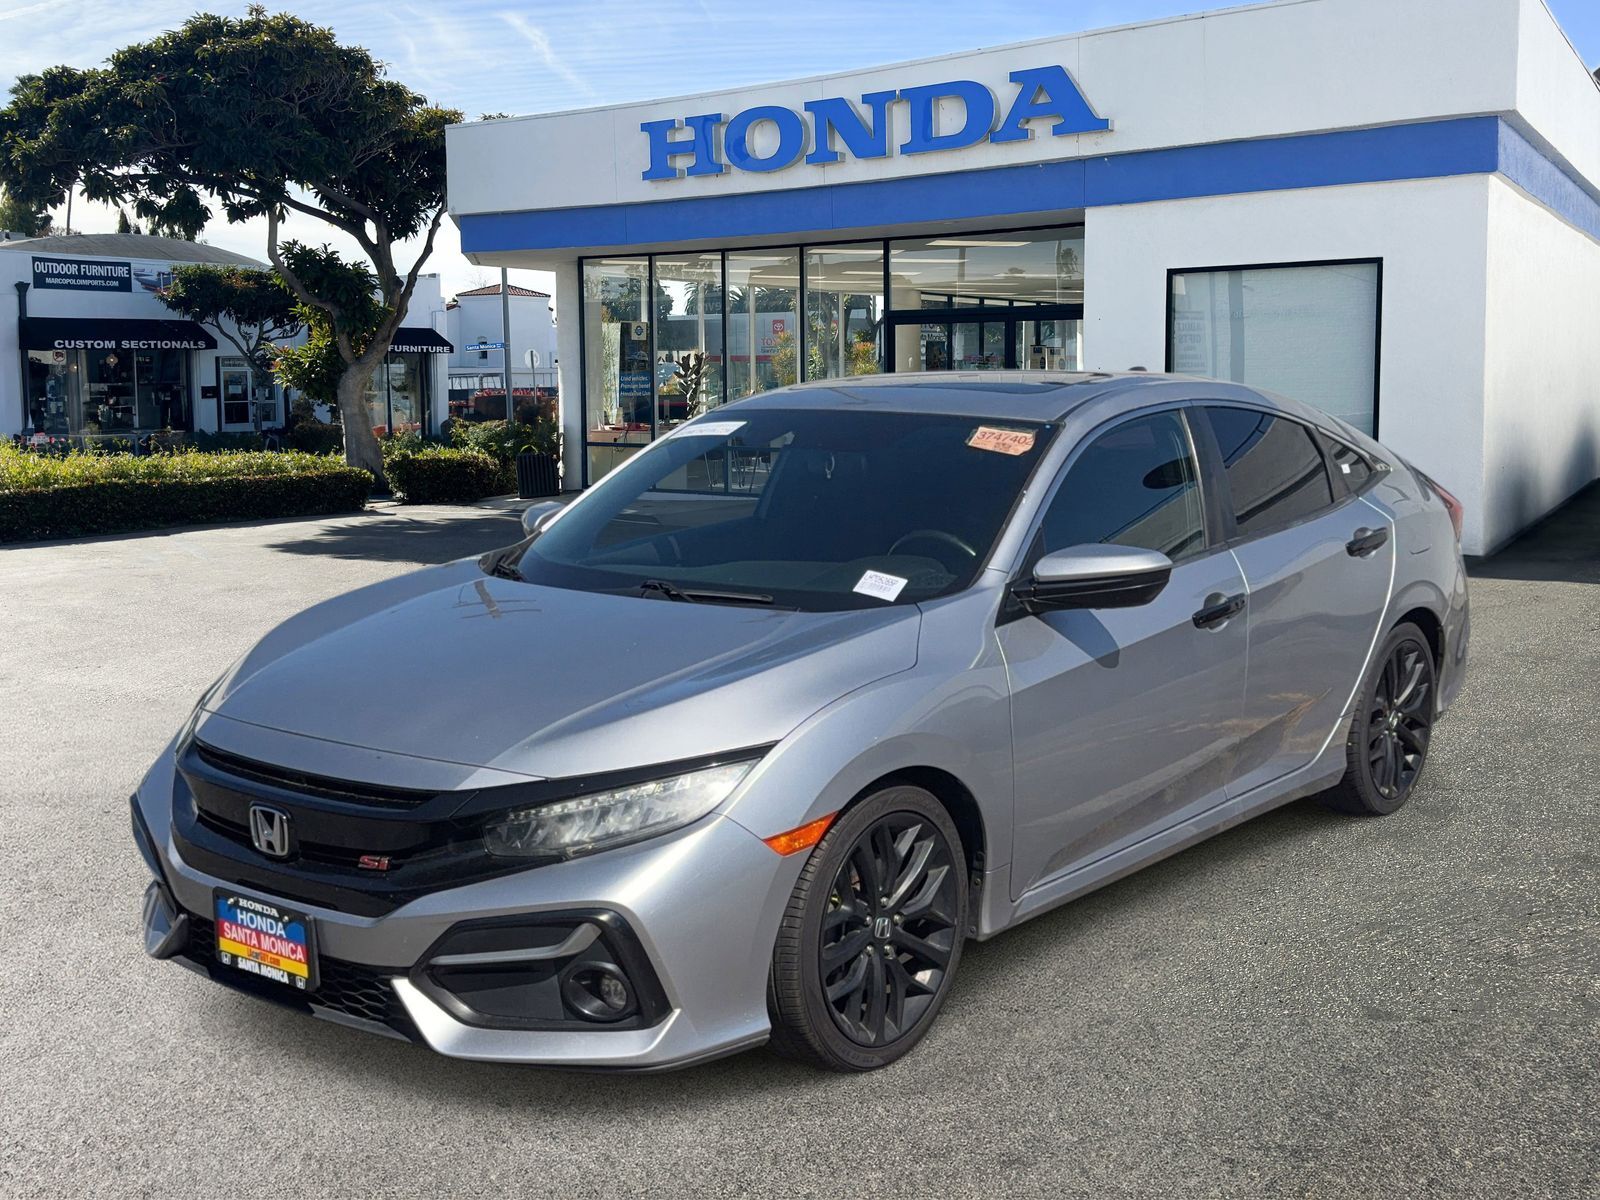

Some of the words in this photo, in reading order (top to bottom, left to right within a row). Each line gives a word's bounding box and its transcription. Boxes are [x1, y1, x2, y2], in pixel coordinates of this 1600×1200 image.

[640, 64, 1111, 181] HONDA
[34, 261, 79, 275] OUTDOOR
[80, 264, 130, 278] FURNITURE
[45, 277, 119, 287] MARCOPOLOIMPORTS.COM
[54, 339, 116, 349] CUSTOM
[121, 340, 206, 349] SECTIONALS
[388, 344, 451, 353] FURNITURE
[358, 855, 390, 870] Si
[238, 897, 280, 918] HONDA
[236, 908, 287, 939] HONDA
[223, 921, 259, 949] SANTA
[259, 933, 305, 963] MONICA
[237, 956, 260, 975] SANTA
[260, 963, 289, 985] MONICA
